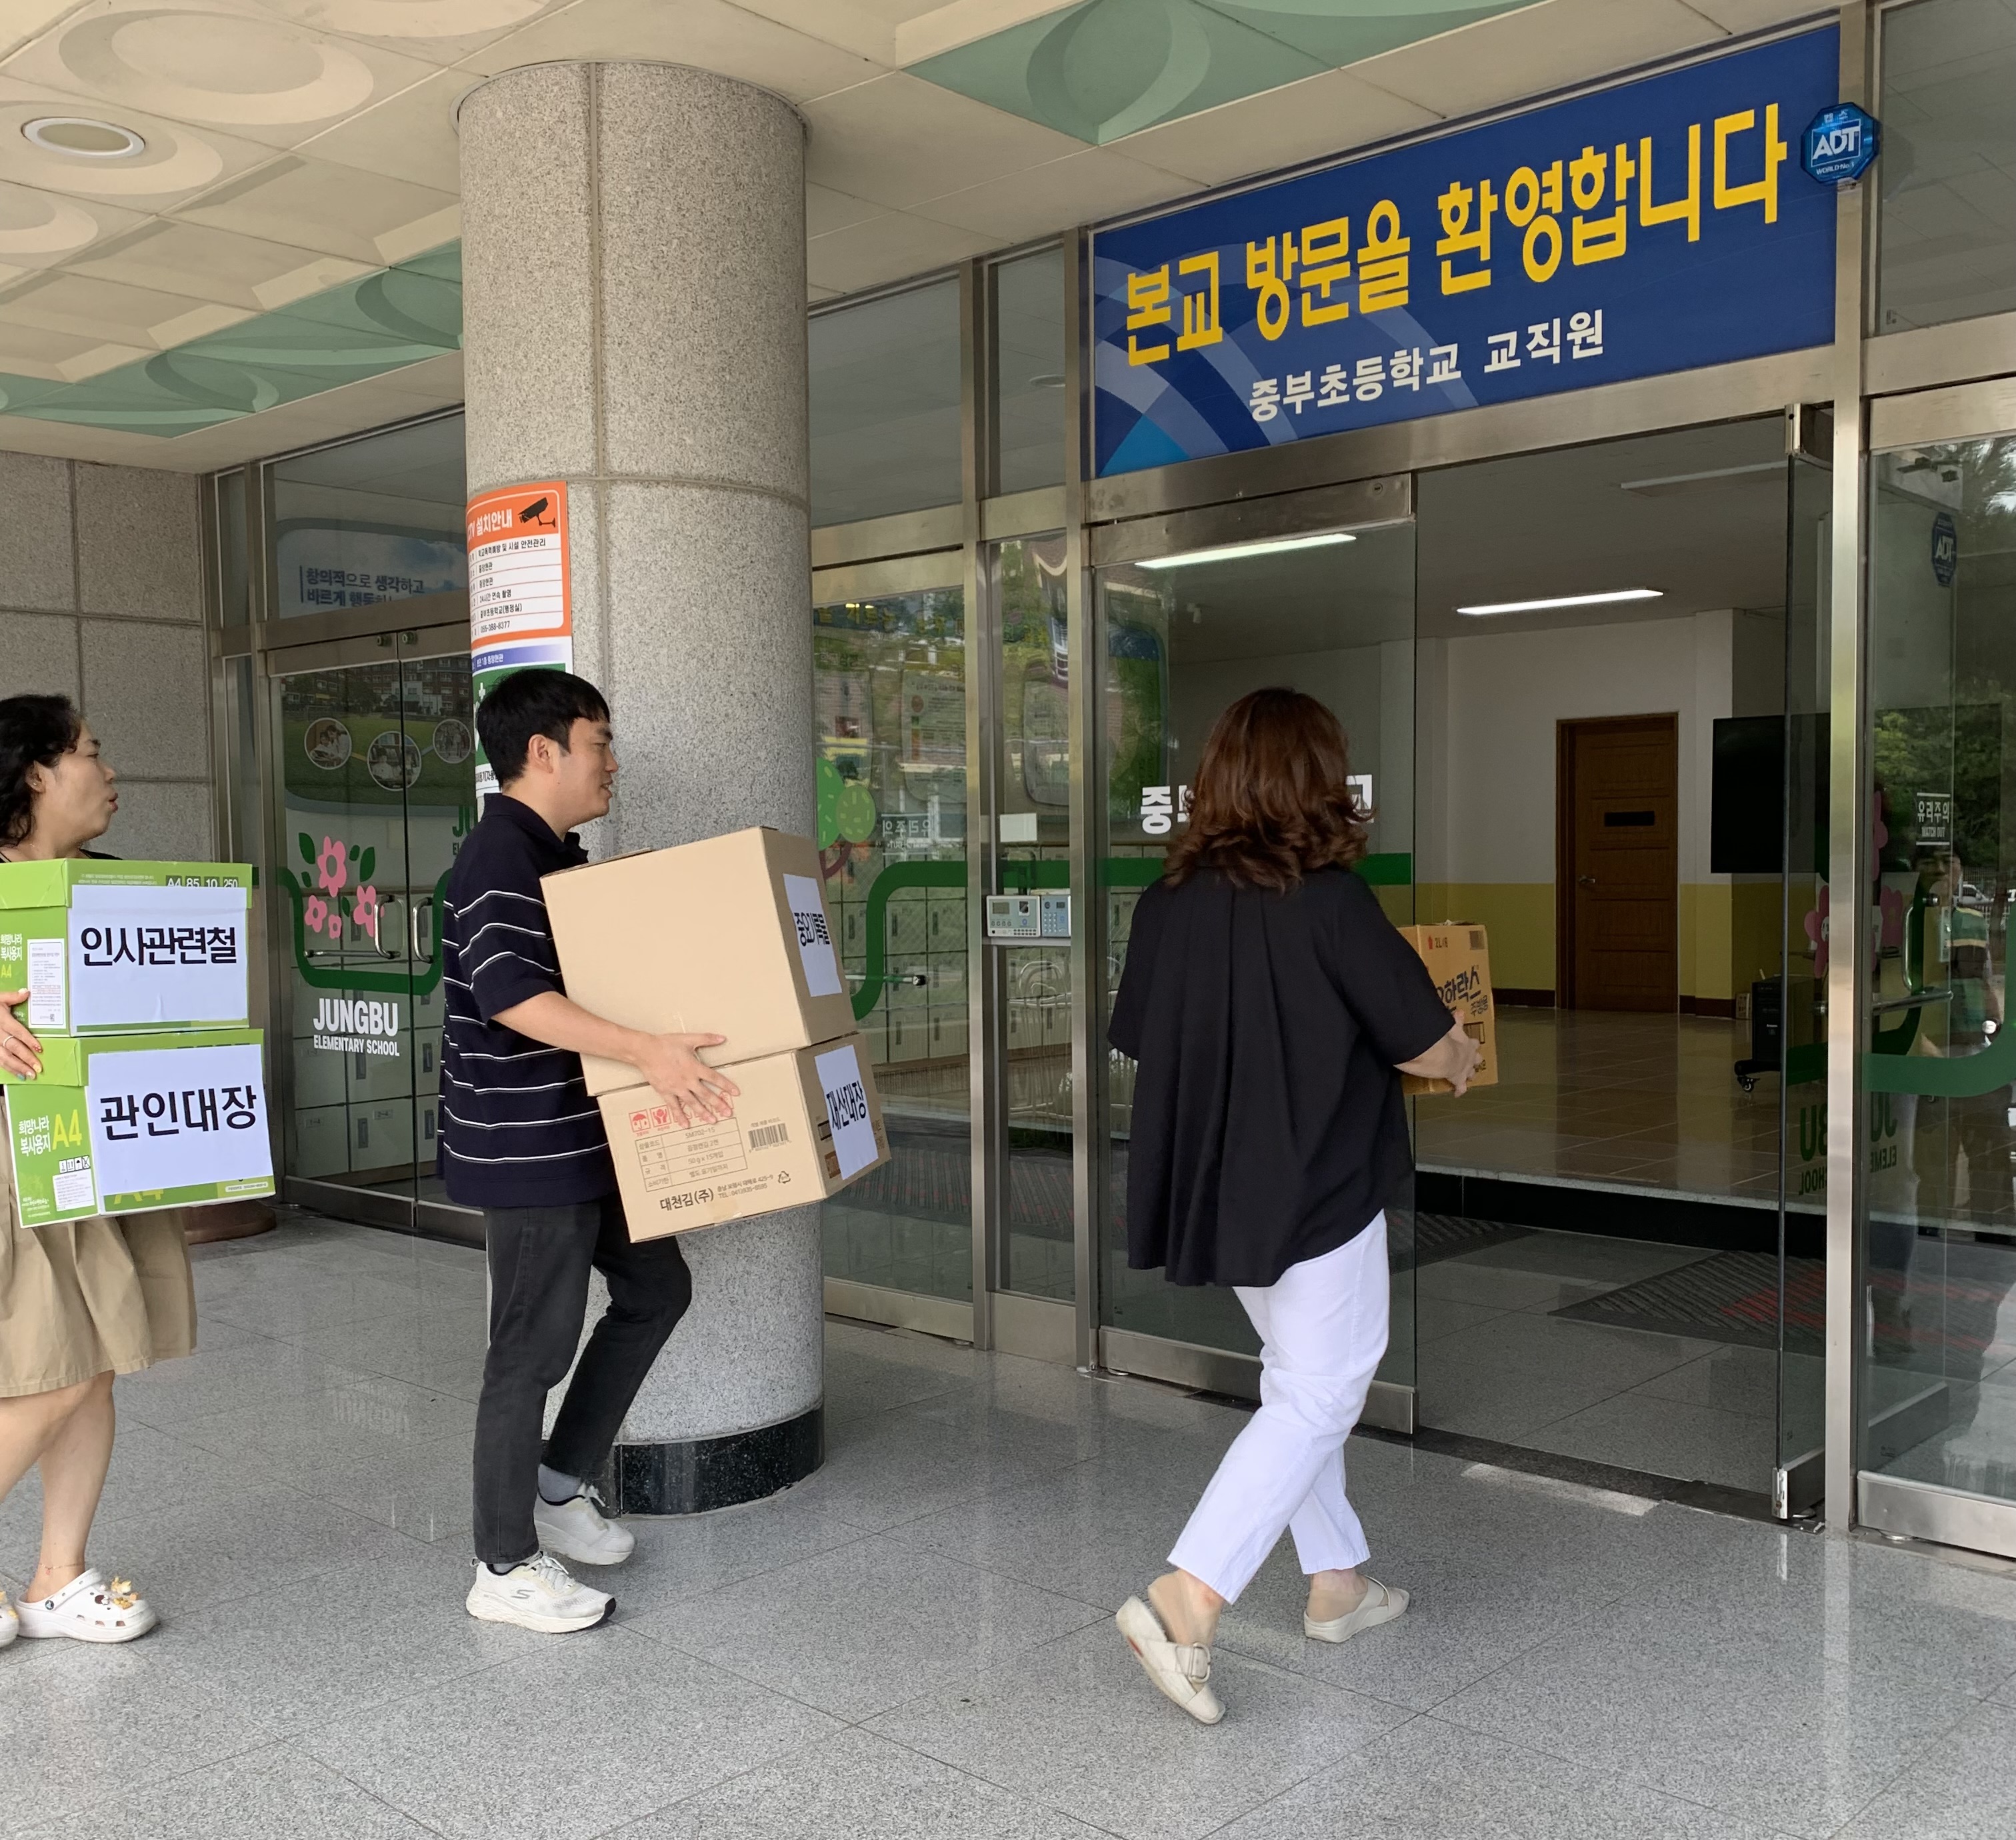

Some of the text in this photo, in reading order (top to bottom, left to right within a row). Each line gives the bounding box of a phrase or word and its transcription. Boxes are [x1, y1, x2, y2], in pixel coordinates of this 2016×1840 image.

[1813, 125, 1860, 160] ADT
[1127, 103, 1787, 366] 본교 방문을 환영합니다
[1249, 309, 1603, 421] 중부초등학교 교직원
[476, 509, 512, 536] 설치안내
[509, 541, 519, 550] 시설
[521, 538, 546, 549] 안전관리
[307, 568, 425, 594] 창의적으로 생각하고
[307, 589, 346, 607] 바르게
[1917, 800, 1950, 823] 유리주의
[81, 927, 237, 966] 인사관련철
[313, 998, 399, 1037] JUNGBU
[313, 1035, 400, 1057] ELEMENTARY SCHOOL
[19, 1115, 49, 1135] 희망나라
[100, 1085, 257, 1141] 관인대장
[52, 1109, 83, 1151] A4
[21, 1132, 51, 1157] 복사용지
[659, 1188, 714, 1211] 대천김(주)
